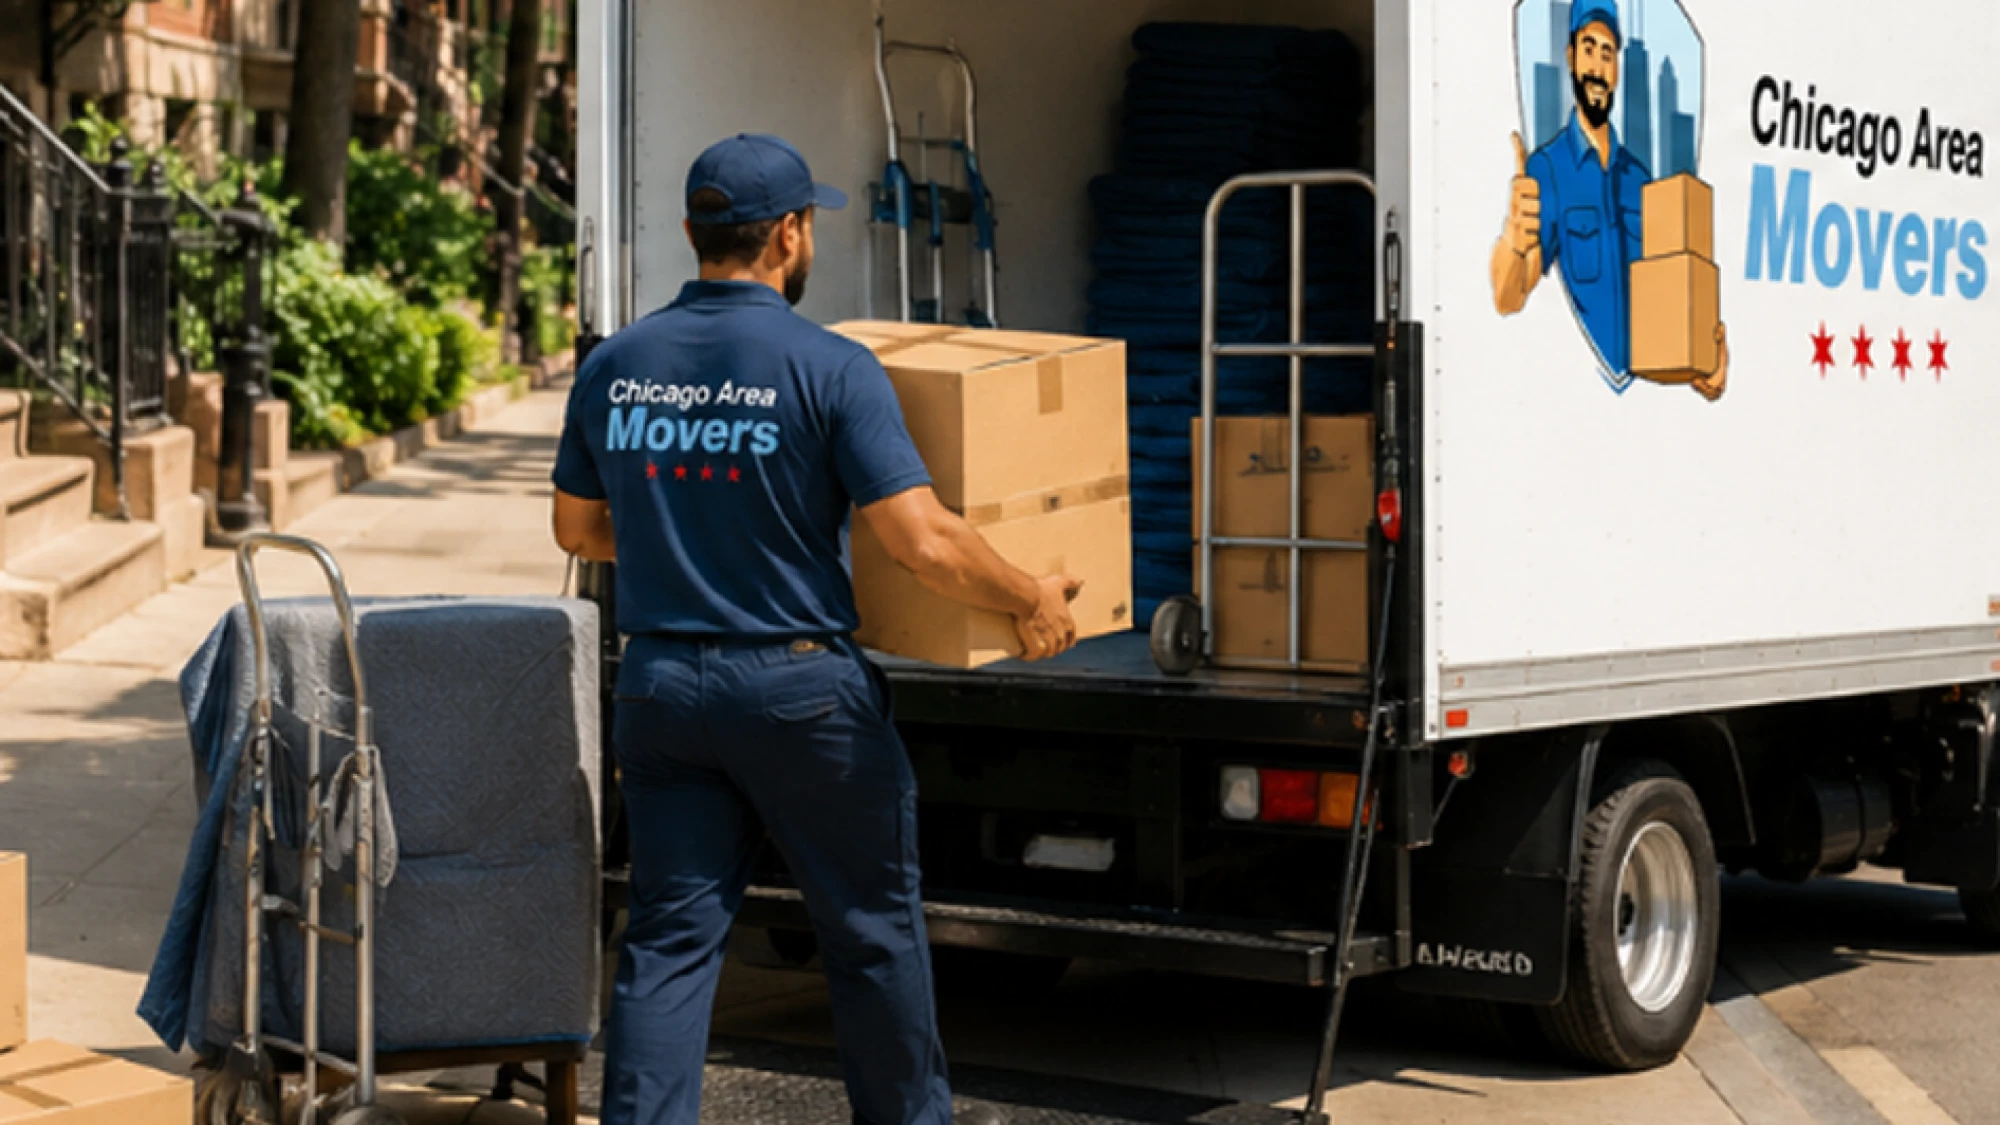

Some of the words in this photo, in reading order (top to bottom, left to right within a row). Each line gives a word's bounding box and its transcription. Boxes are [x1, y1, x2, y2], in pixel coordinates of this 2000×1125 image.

[1751, 75, 1901, 178] Chicago
[1908, 107, 1984, 178] Area
[1744, 163, 1988, 300] Movers
[606, 405, 780, 455] Movers
[608, 378, 711, 412] Chicago
[715, 379, 777, 407] Area
